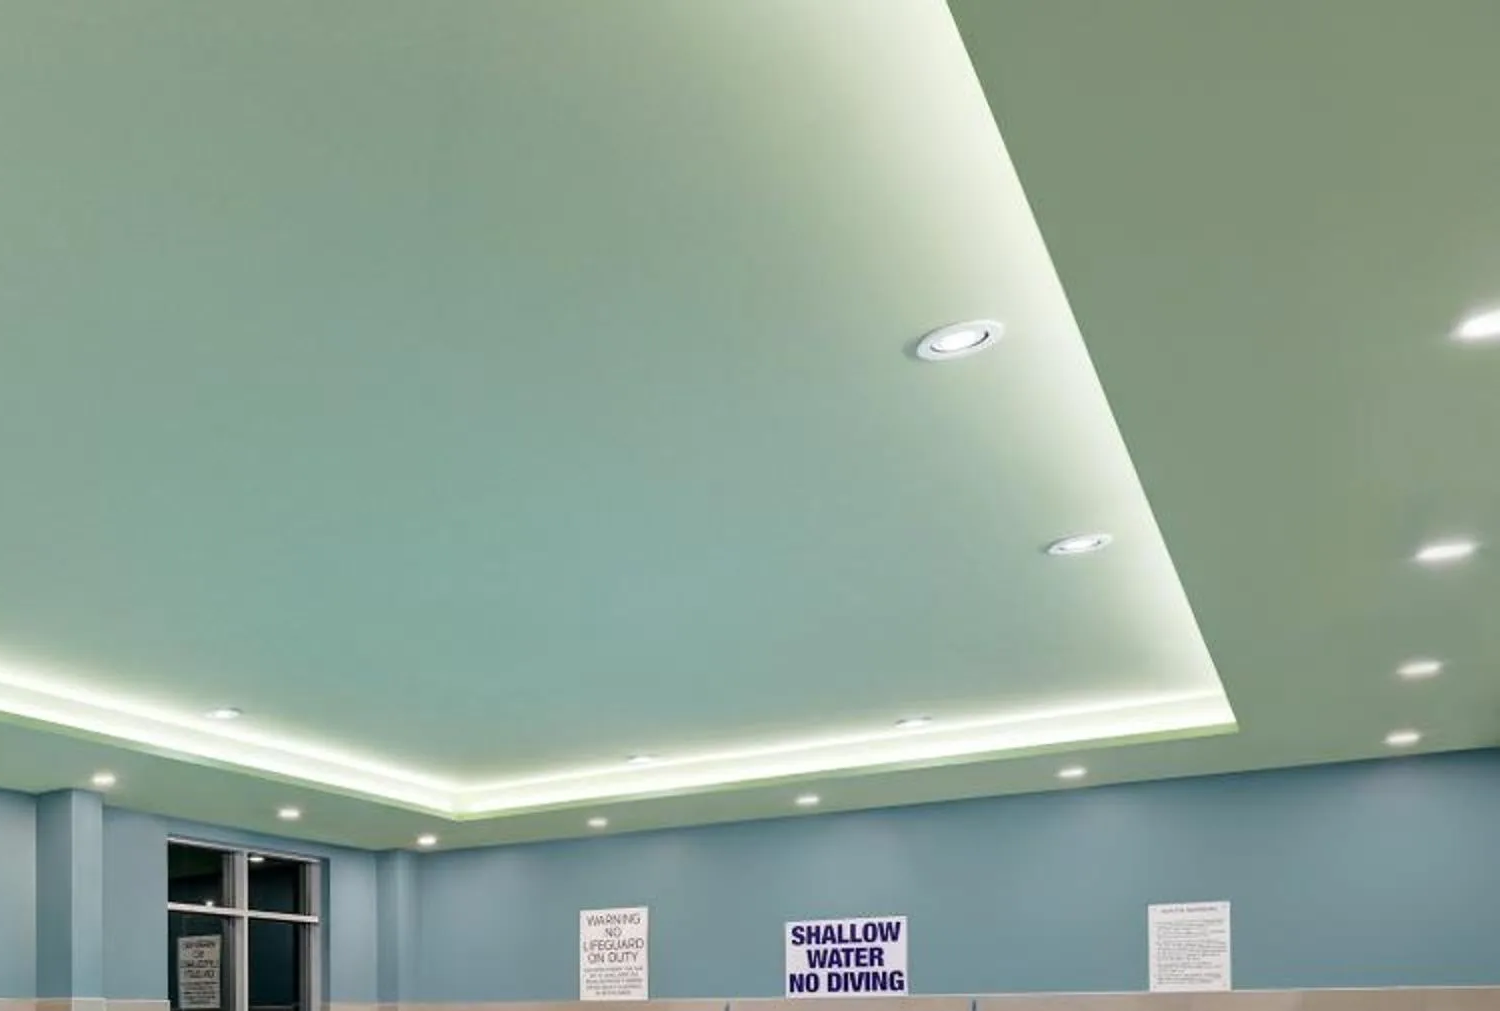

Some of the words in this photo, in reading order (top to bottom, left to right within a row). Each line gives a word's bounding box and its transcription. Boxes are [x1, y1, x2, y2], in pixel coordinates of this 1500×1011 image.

[586, 913, 641, 926] WARNING
[605, 926, 622, 938] NO
[791, 921, 901, 946] SHALLOW
[583, 937, 644, 952] LIFEGUARD
[587, 952, 605, 964] ON
[607, 951, 638, 963] DUTY
[806, 947, 885, 969] WATER
[789, 972, 820, 993] NO
[827, 970, 904, 992] DIVING
